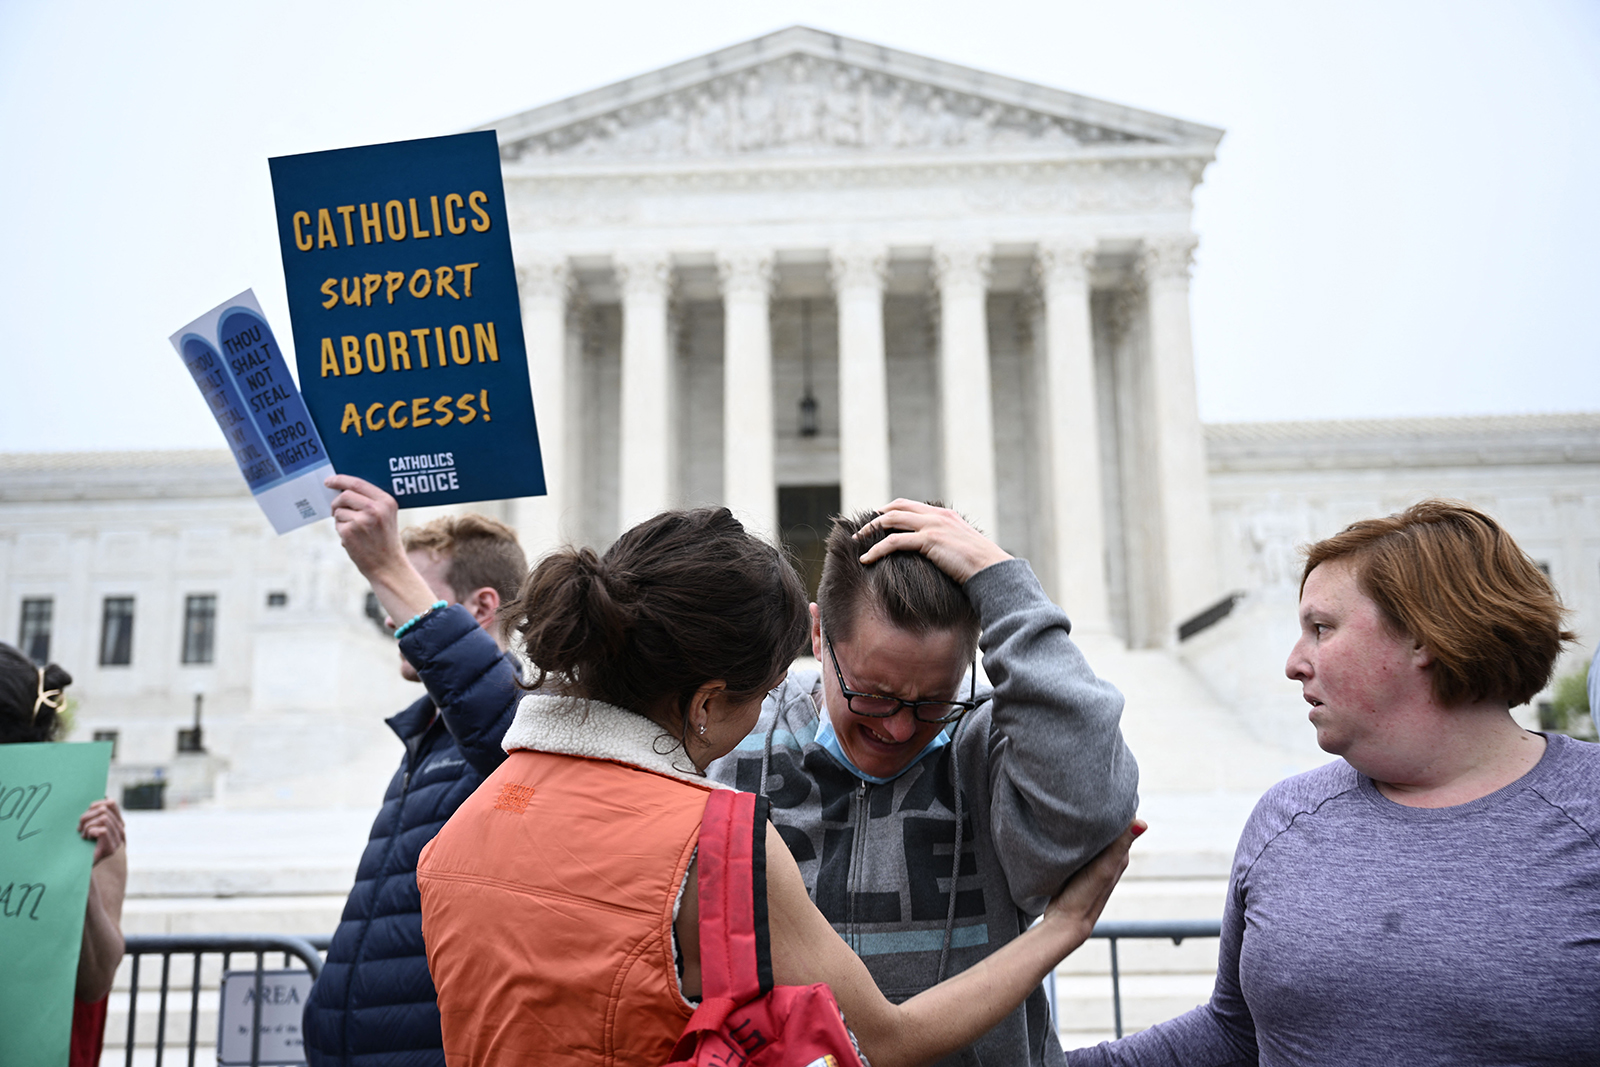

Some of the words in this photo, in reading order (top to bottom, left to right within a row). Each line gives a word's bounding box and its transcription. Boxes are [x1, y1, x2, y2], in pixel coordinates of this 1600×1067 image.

[293, 190, 491, 251] CATHOLICS
[320, 262, 479, 310] SUPPORT
[223, 325, 261, 355] THOU
[321, 322, 499, 377] ABORTION
[232, 343, 272, 376] SHALT
[246, 366, 273, 392] NOT
[250, 384, 291, 413] STEAL
[340, 389, 492, 437] ACCESS!
[267, 406, 287, 427] MY
[267, 421, 307, 449] REPRO
[276, 438, 318, 468] RIGHTS
[388, 452, 455, 472] CATHOLICS
[392, 471, 460, 496] CHOICE
[0, 782, 52, 841] on
